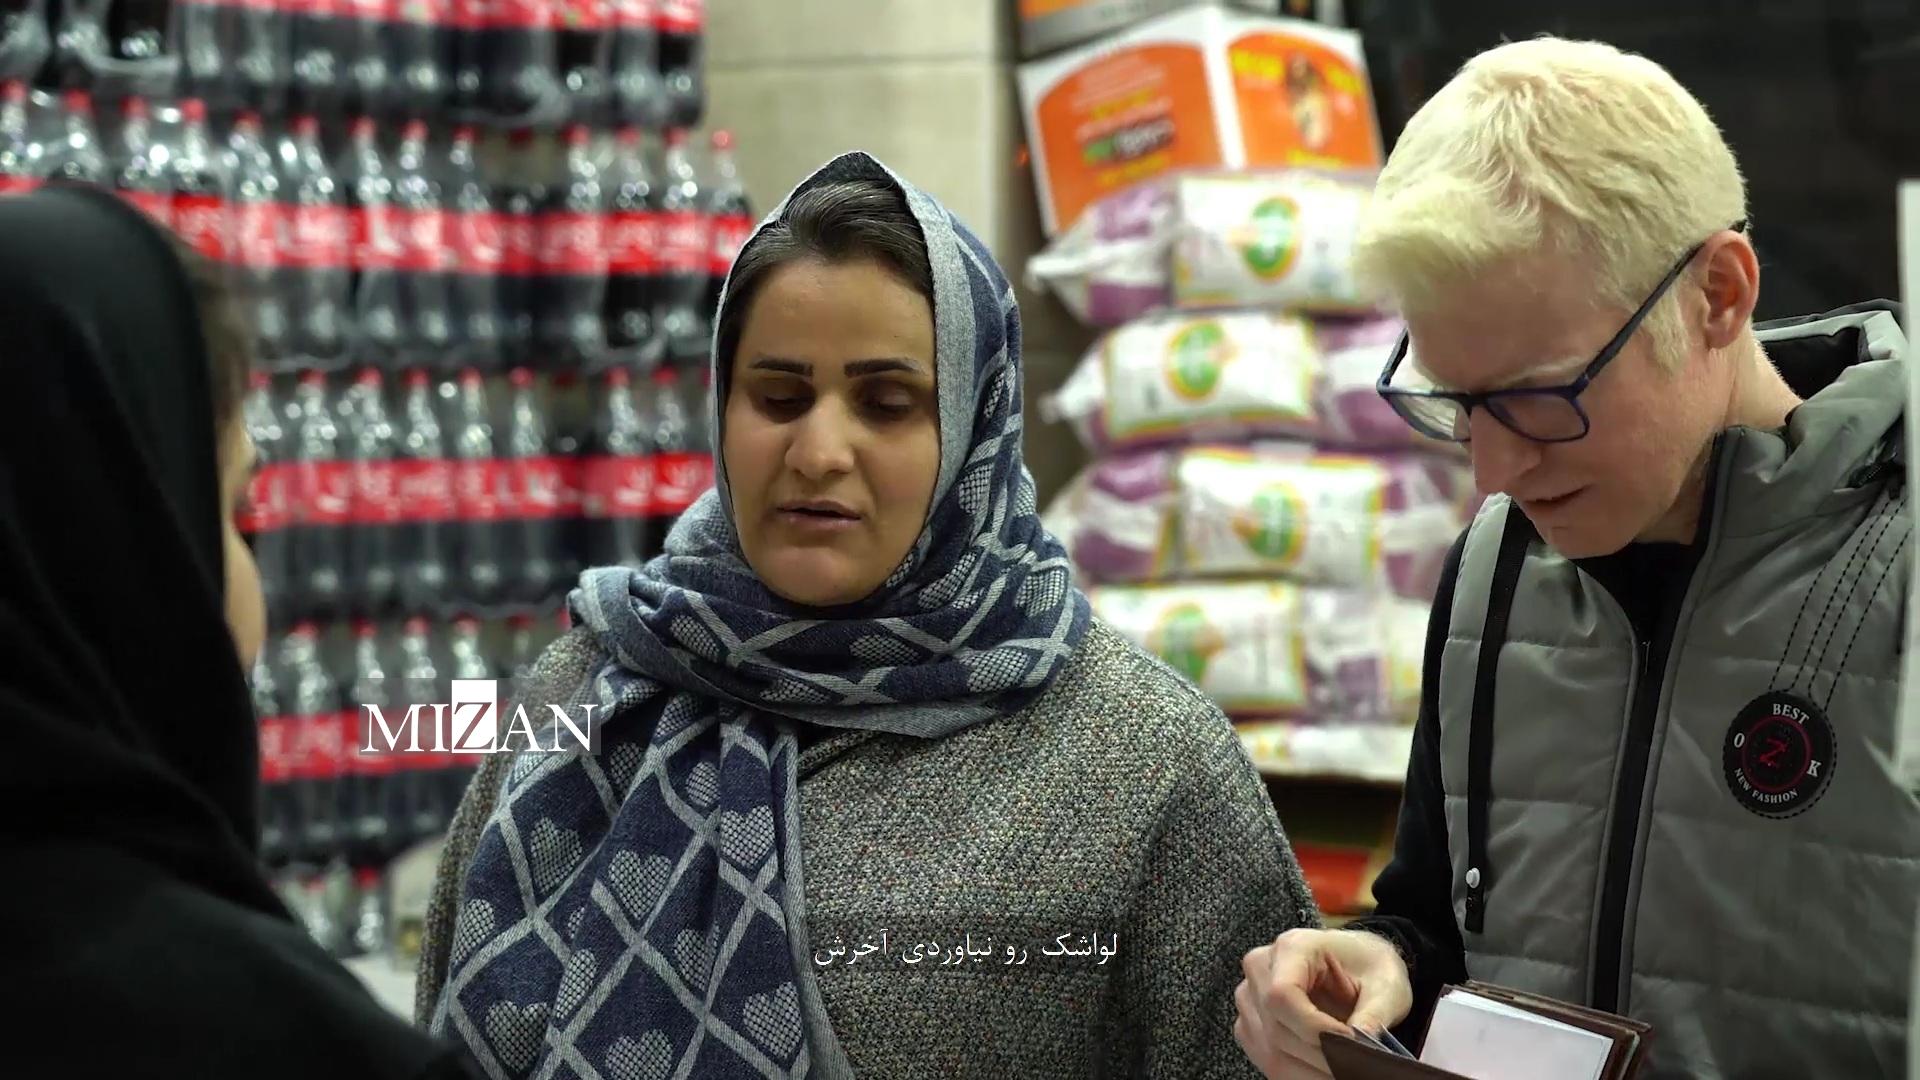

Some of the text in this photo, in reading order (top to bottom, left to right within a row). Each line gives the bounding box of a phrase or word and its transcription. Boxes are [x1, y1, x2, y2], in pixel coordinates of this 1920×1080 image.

[1772, 703, 1810, 725] BEST
[1806, 759, 1822, 777] K
[1734, 767, 1799, 804] NEW FASHION
